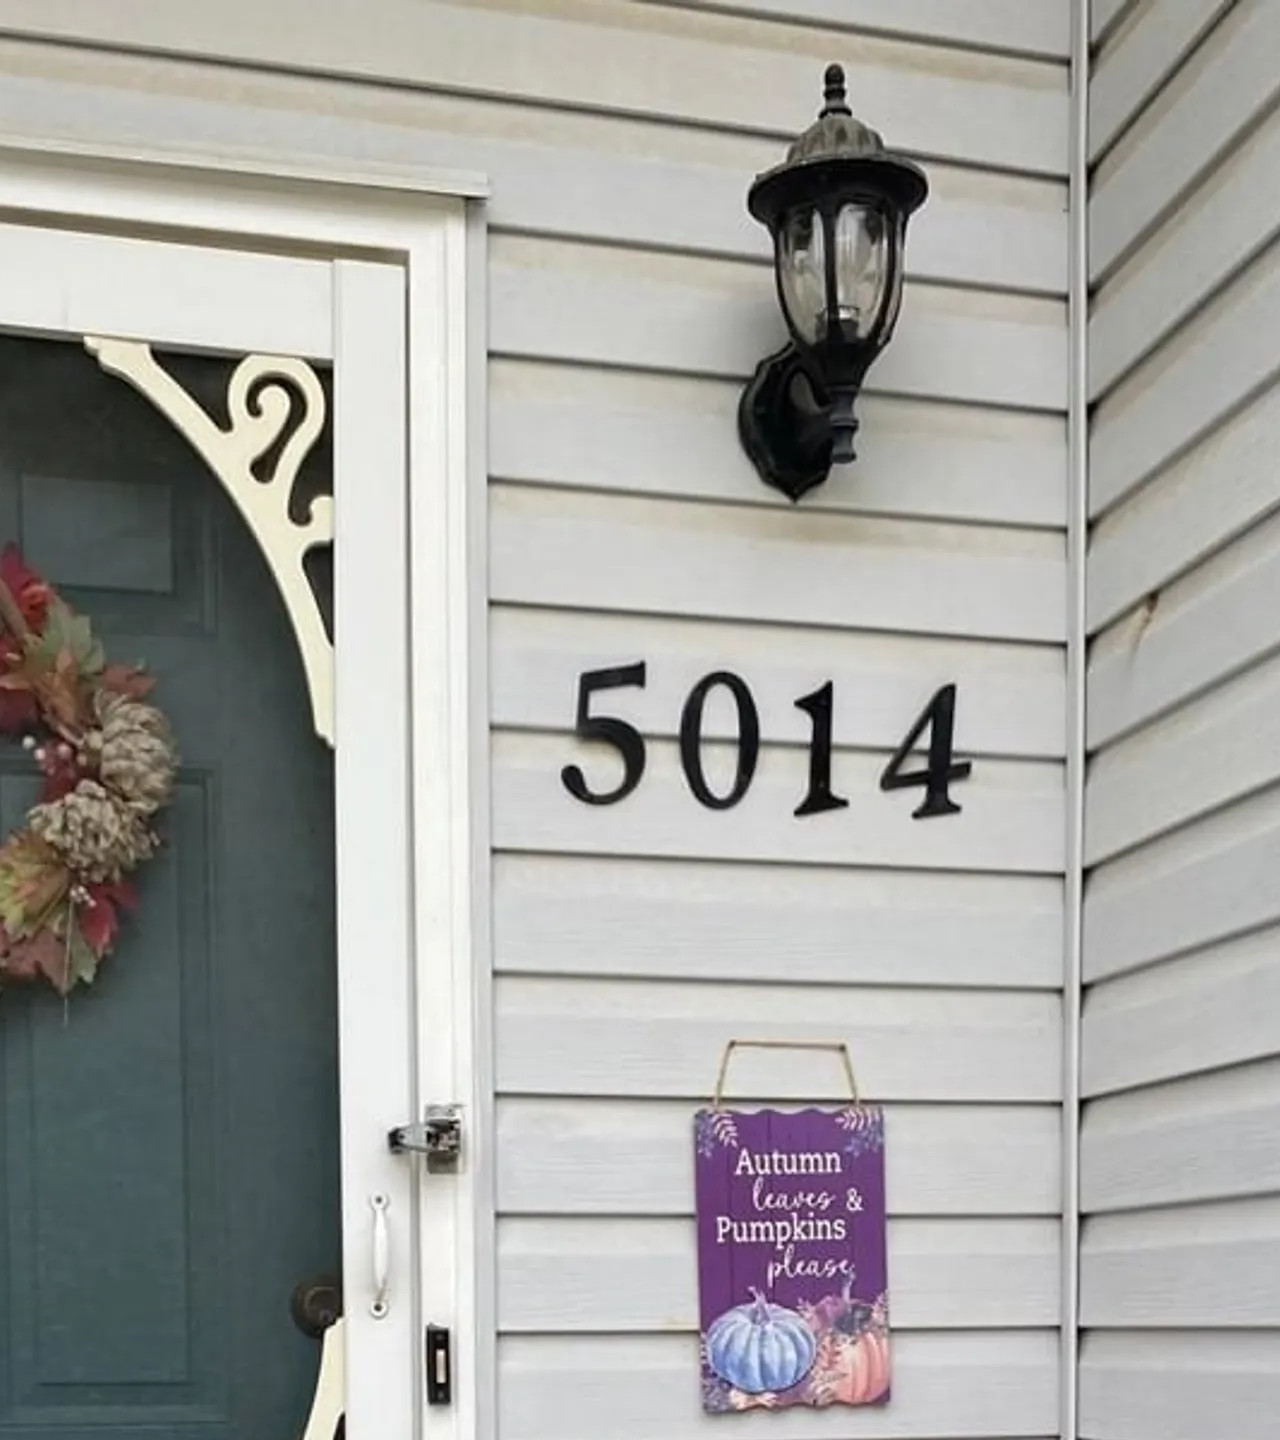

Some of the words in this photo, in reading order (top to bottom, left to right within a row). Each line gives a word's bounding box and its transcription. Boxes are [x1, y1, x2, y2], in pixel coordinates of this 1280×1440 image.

[561, 660, 972, 819] 5014
[734, 1148, 842, 1175] Autumn
[752, 1176, 835, 1211] leaves
[846, 1187, 864, 1211] &
[716, 1212, 846, 1250] Pumpkins
[767, 1243, 855, 1287] please
